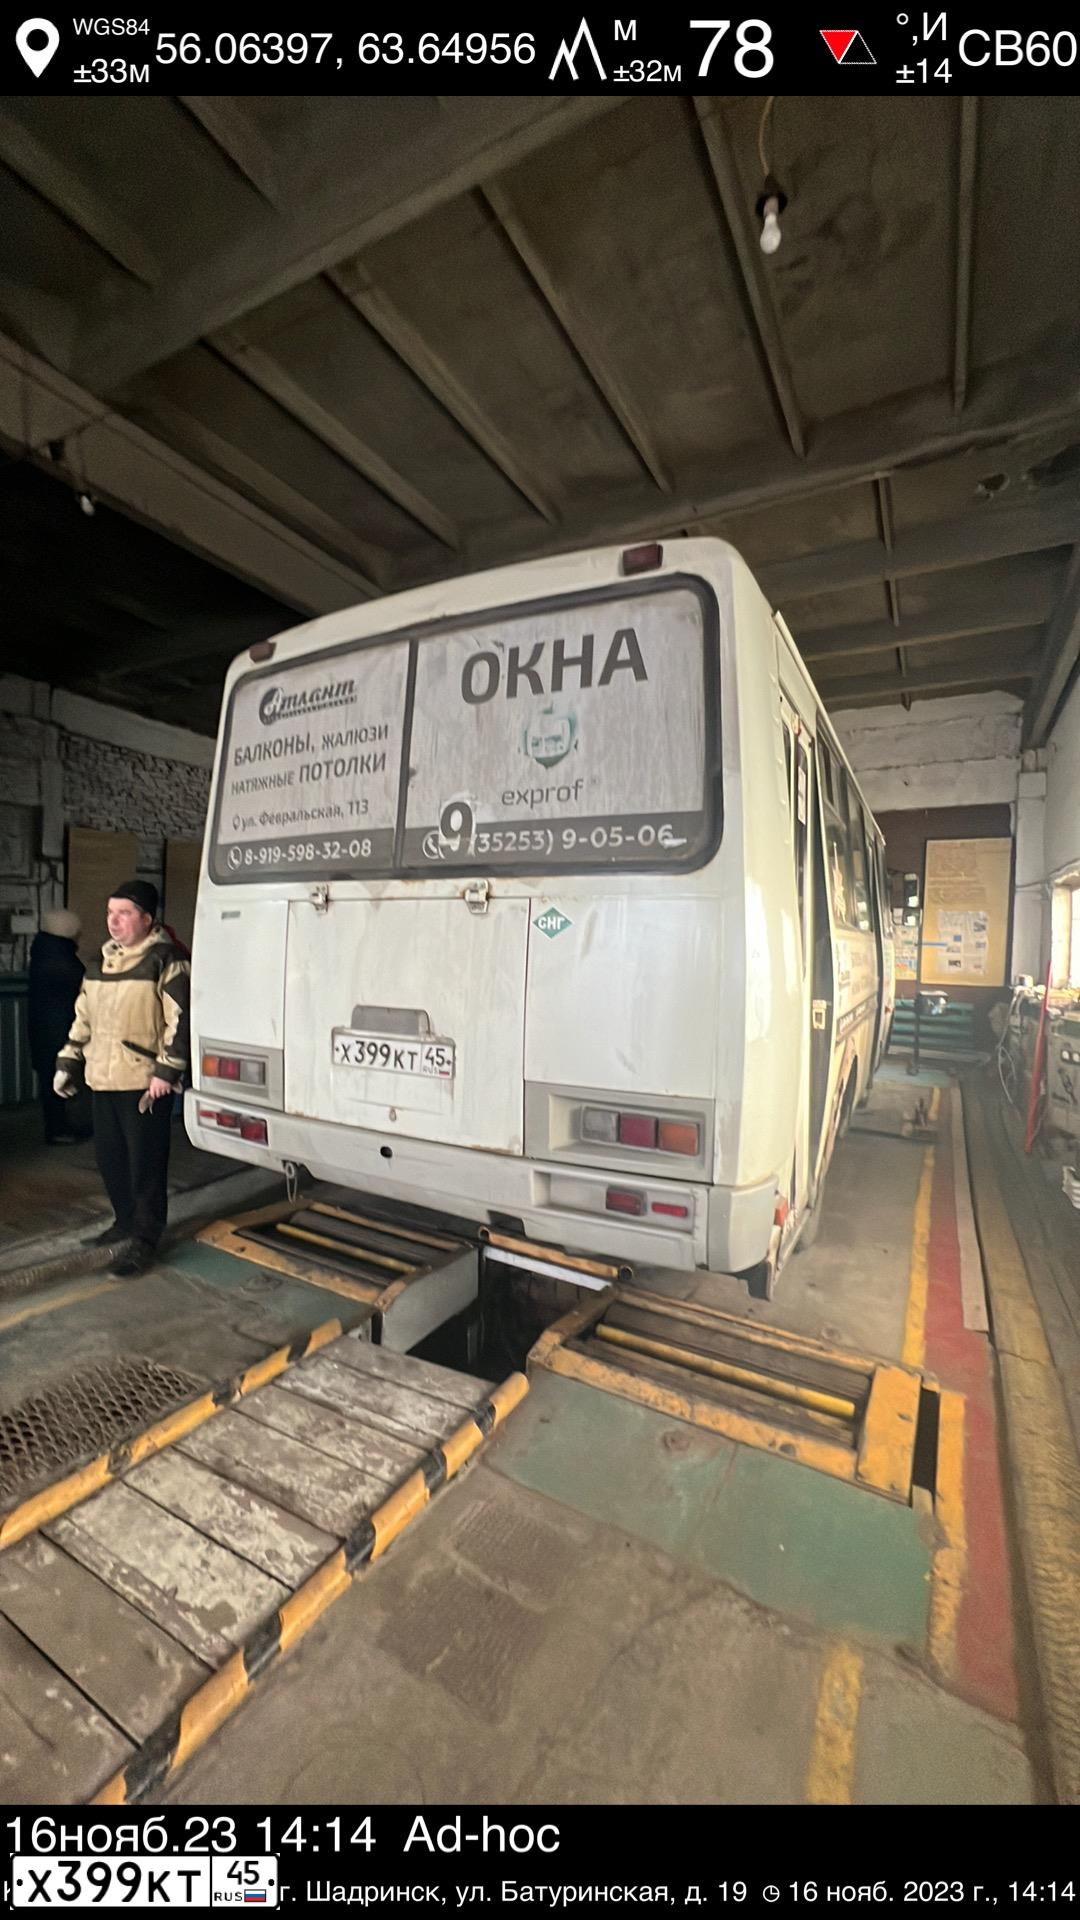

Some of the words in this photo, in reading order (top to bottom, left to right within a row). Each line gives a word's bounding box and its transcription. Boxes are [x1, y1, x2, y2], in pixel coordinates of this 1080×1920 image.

[460, 627, 648, 704] ОКНА
[234, 731, 315, 767] БАЛКОНЫ,
[321, 724, 388, 750] ЖАЛЮЗИ
[231, 770, 295, 795] НАТЯЖНЫЕ
[299, 752, 386, 783] ПОТОЛКИ
[501, 778, 584, 810] exprof
[259, 805, 344, 827] Февральская,
[348, 800, 369, 816] 113
[244, 838, 371, 866] 8-919-598-32-08
[538, 916, 565, 930] СНГ
[425, 1046, 445, 1067] 45
